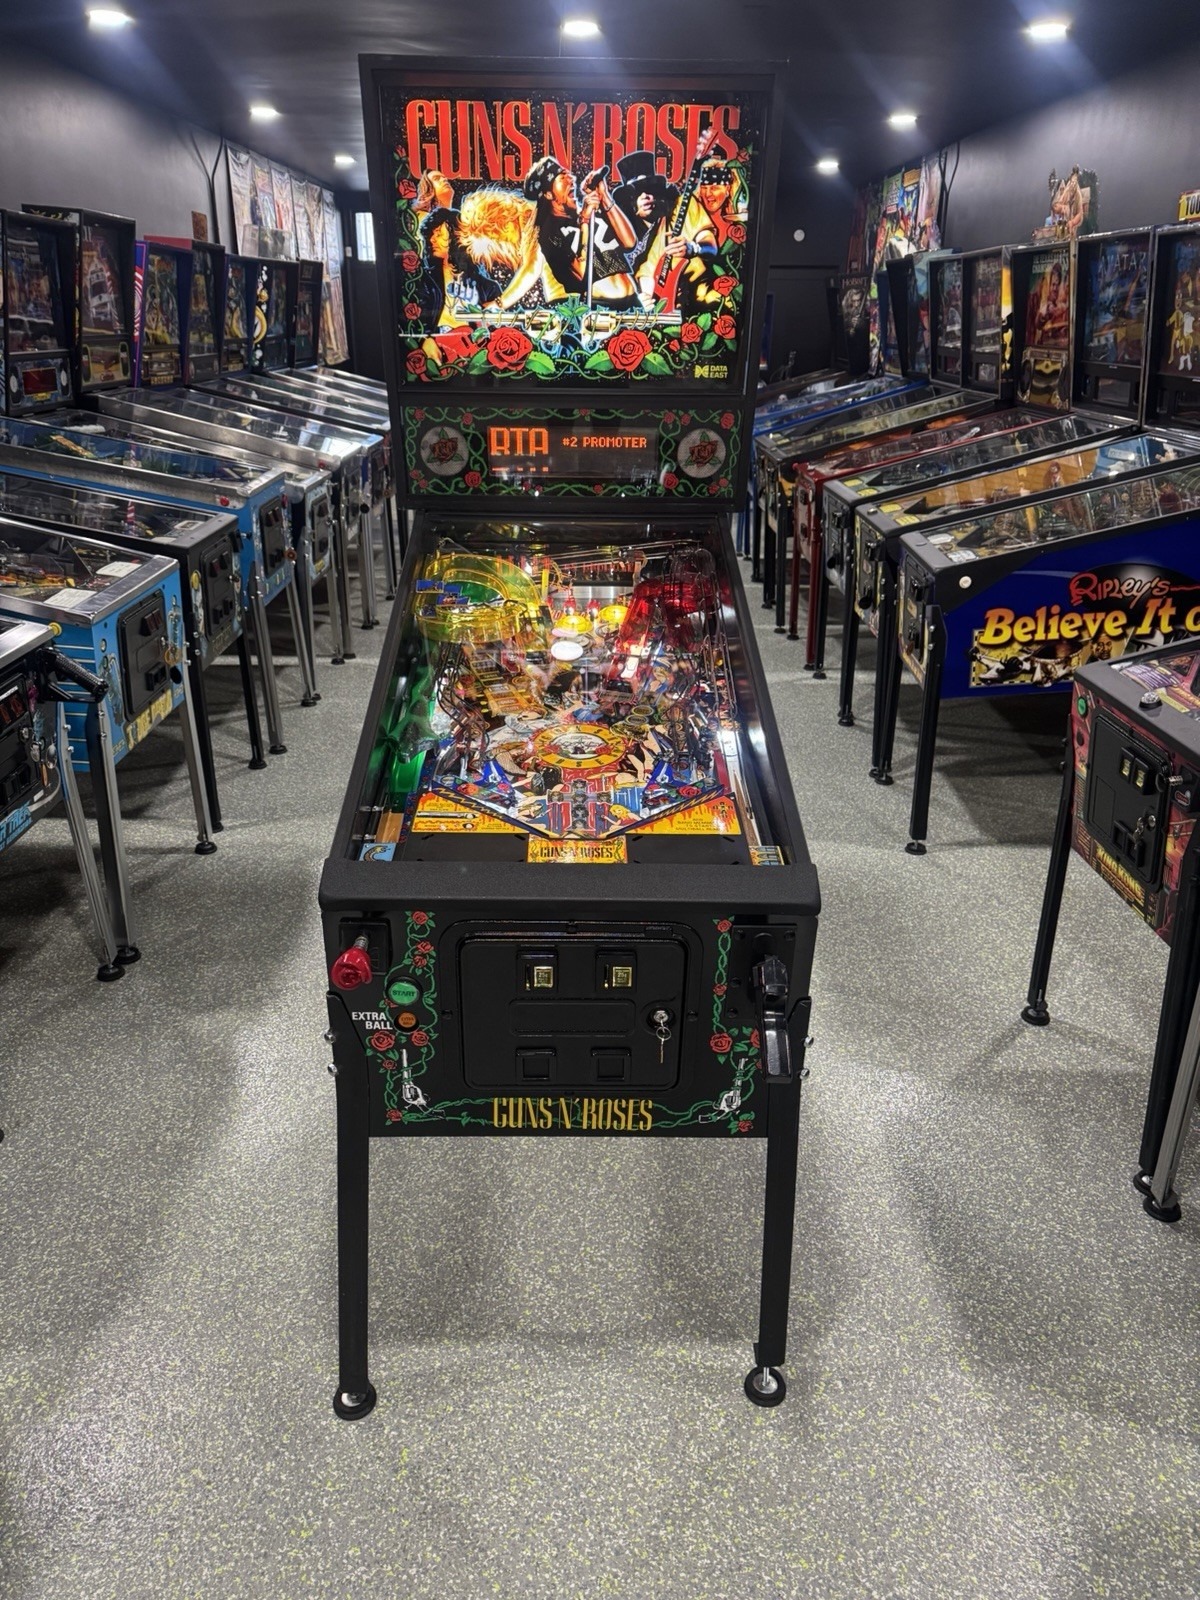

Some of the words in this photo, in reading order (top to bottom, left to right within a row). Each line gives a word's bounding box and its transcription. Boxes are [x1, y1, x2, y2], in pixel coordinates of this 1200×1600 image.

[406, 99, 532, 182] GUNS
[591, 103, 741, 184] ROSES
[489, 427, 549, 456] RTA
[562, 436, 578, 447] #2
[582, 436, 647, 448] PROMOTER
[978, 604, 1127, 645] Believe
[1136, 598, 1177, 635] It
[351, 1012, 387, 1020] EXTRA
[365, 1021, 393, 1030] BALL
[493, 1097, 552, 1129] GUNS
[582, 1098, 653, 1131] ROSES
